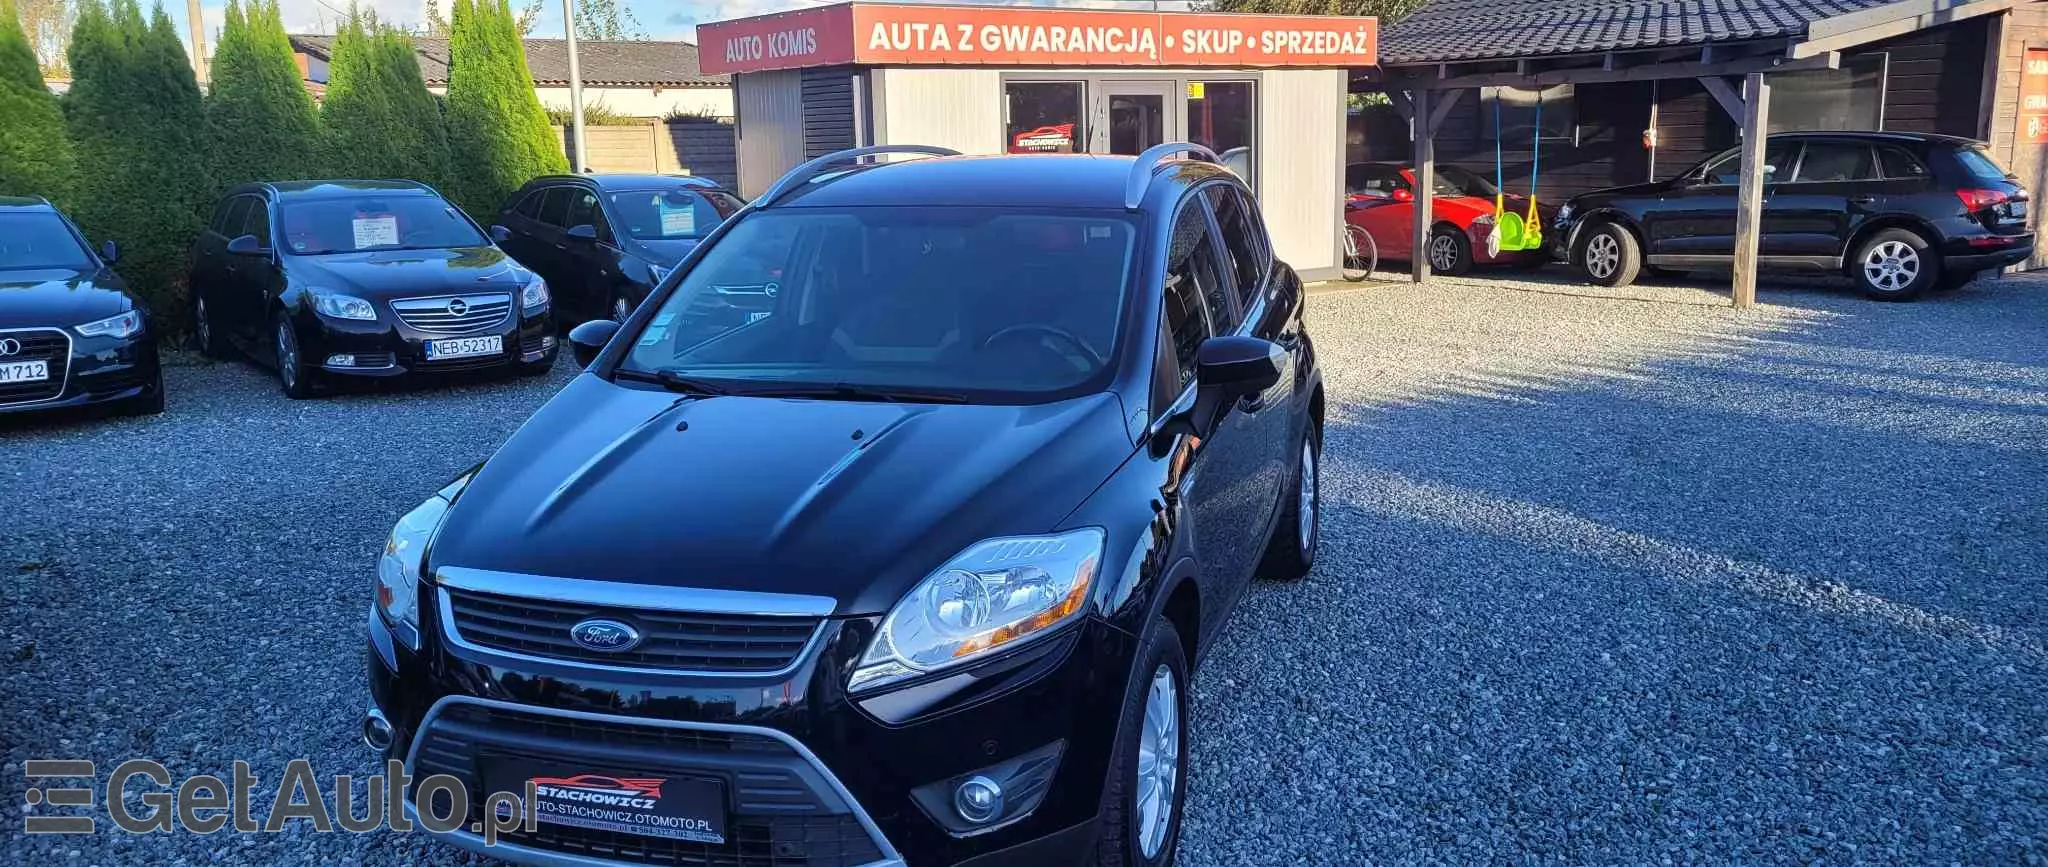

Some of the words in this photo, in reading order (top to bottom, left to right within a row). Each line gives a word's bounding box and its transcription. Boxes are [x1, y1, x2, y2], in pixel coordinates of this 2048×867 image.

[725, 36, 763, 63] AUTO
[768, 27, 817, 58] KOMIS
[869, 22, 951, 50] AUTA
[957, 24, 973, 51] Z
[980, 23, 1157, 60] GWARANCJĄ
[1182, 29, 1243, 54] SKUP
[1261, 26, 1368, 55] SPRZEDAŻ
[433, 341, 459, 356] NEB
[463, 337, 500, 353] 52317
[13, 364, 46, 379] 712
[584, 626, 620, 644] Ford
[536, 785, 657, 809] STACHOWICZ
